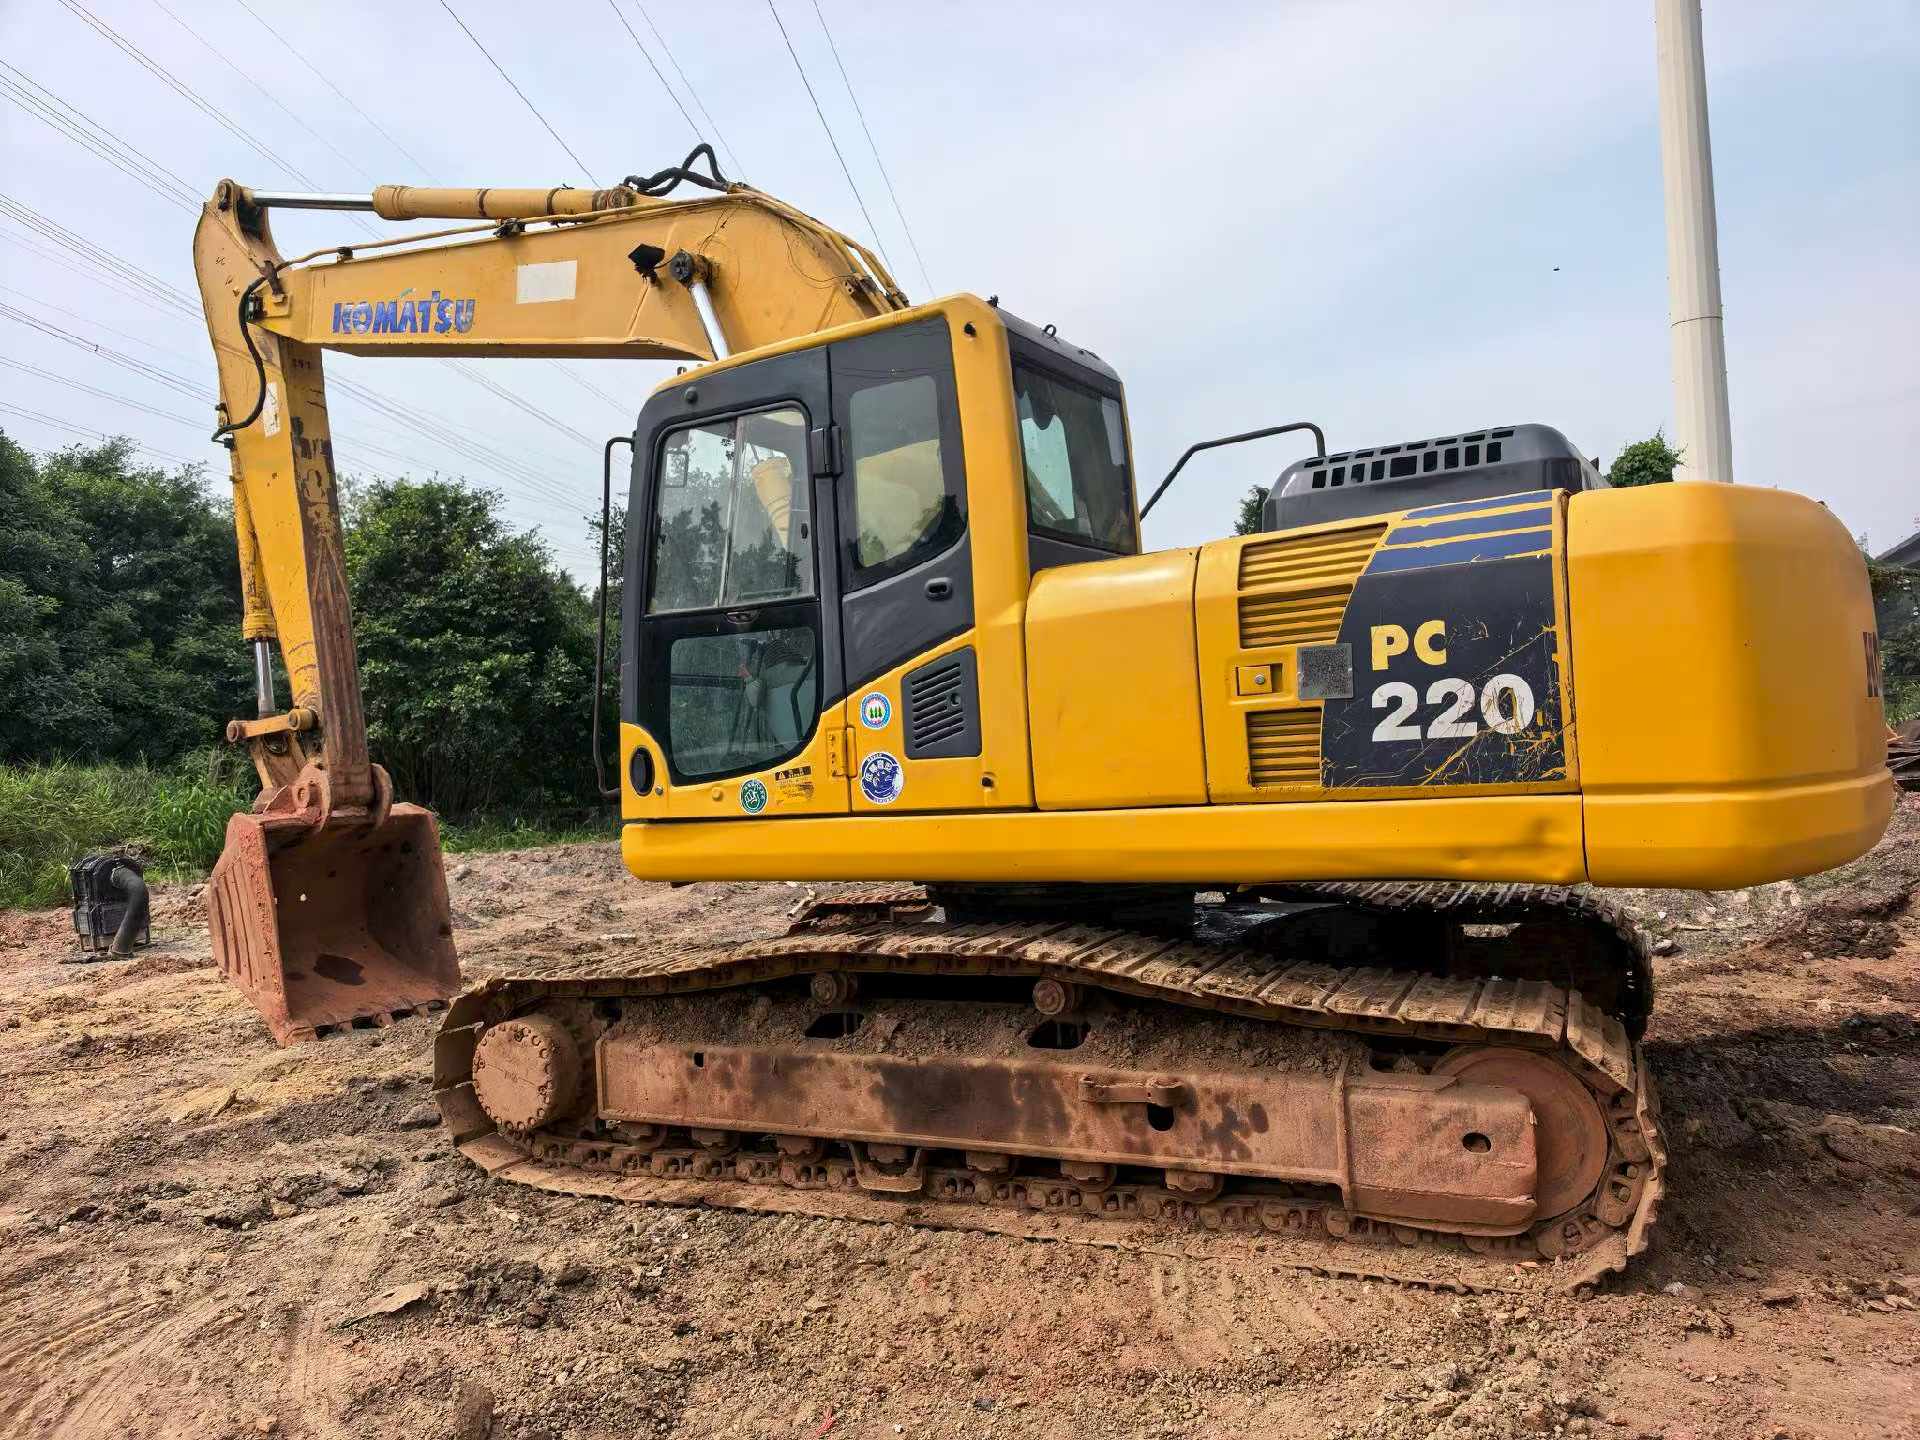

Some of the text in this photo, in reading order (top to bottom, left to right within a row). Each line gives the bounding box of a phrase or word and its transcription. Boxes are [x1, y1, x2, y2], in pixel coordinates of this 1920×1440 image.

[333, 291, 476, 334] KOMATSU
[1370, 620, 1447, 671] PC
[1371, 673, 1535, 743] 220
